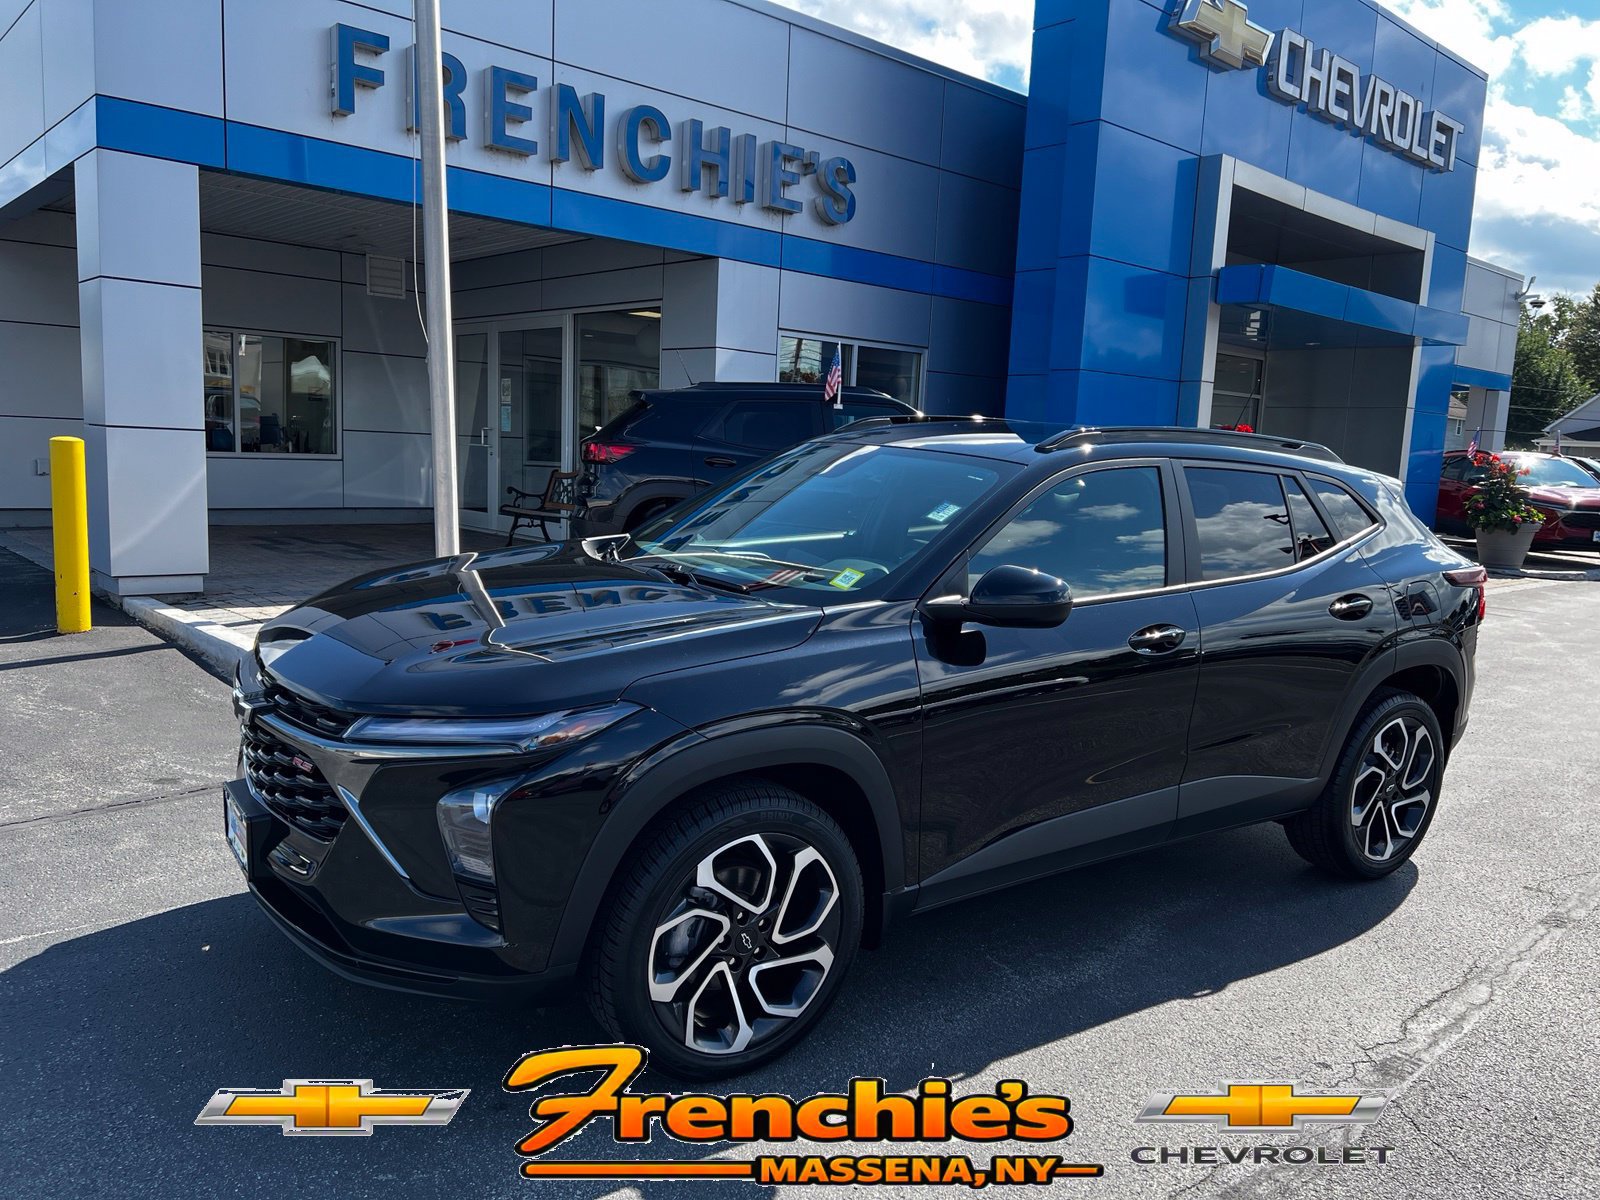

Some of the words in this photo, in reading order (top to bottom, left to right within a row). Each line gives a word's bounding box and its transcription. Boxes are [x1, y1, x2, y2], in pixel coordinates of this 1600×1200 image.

[330, 22, 857, 226] FRENCHIE'S
[1272, 27, 1465, 172] CHEVROLET
[293, 757, 313, 773] RS
